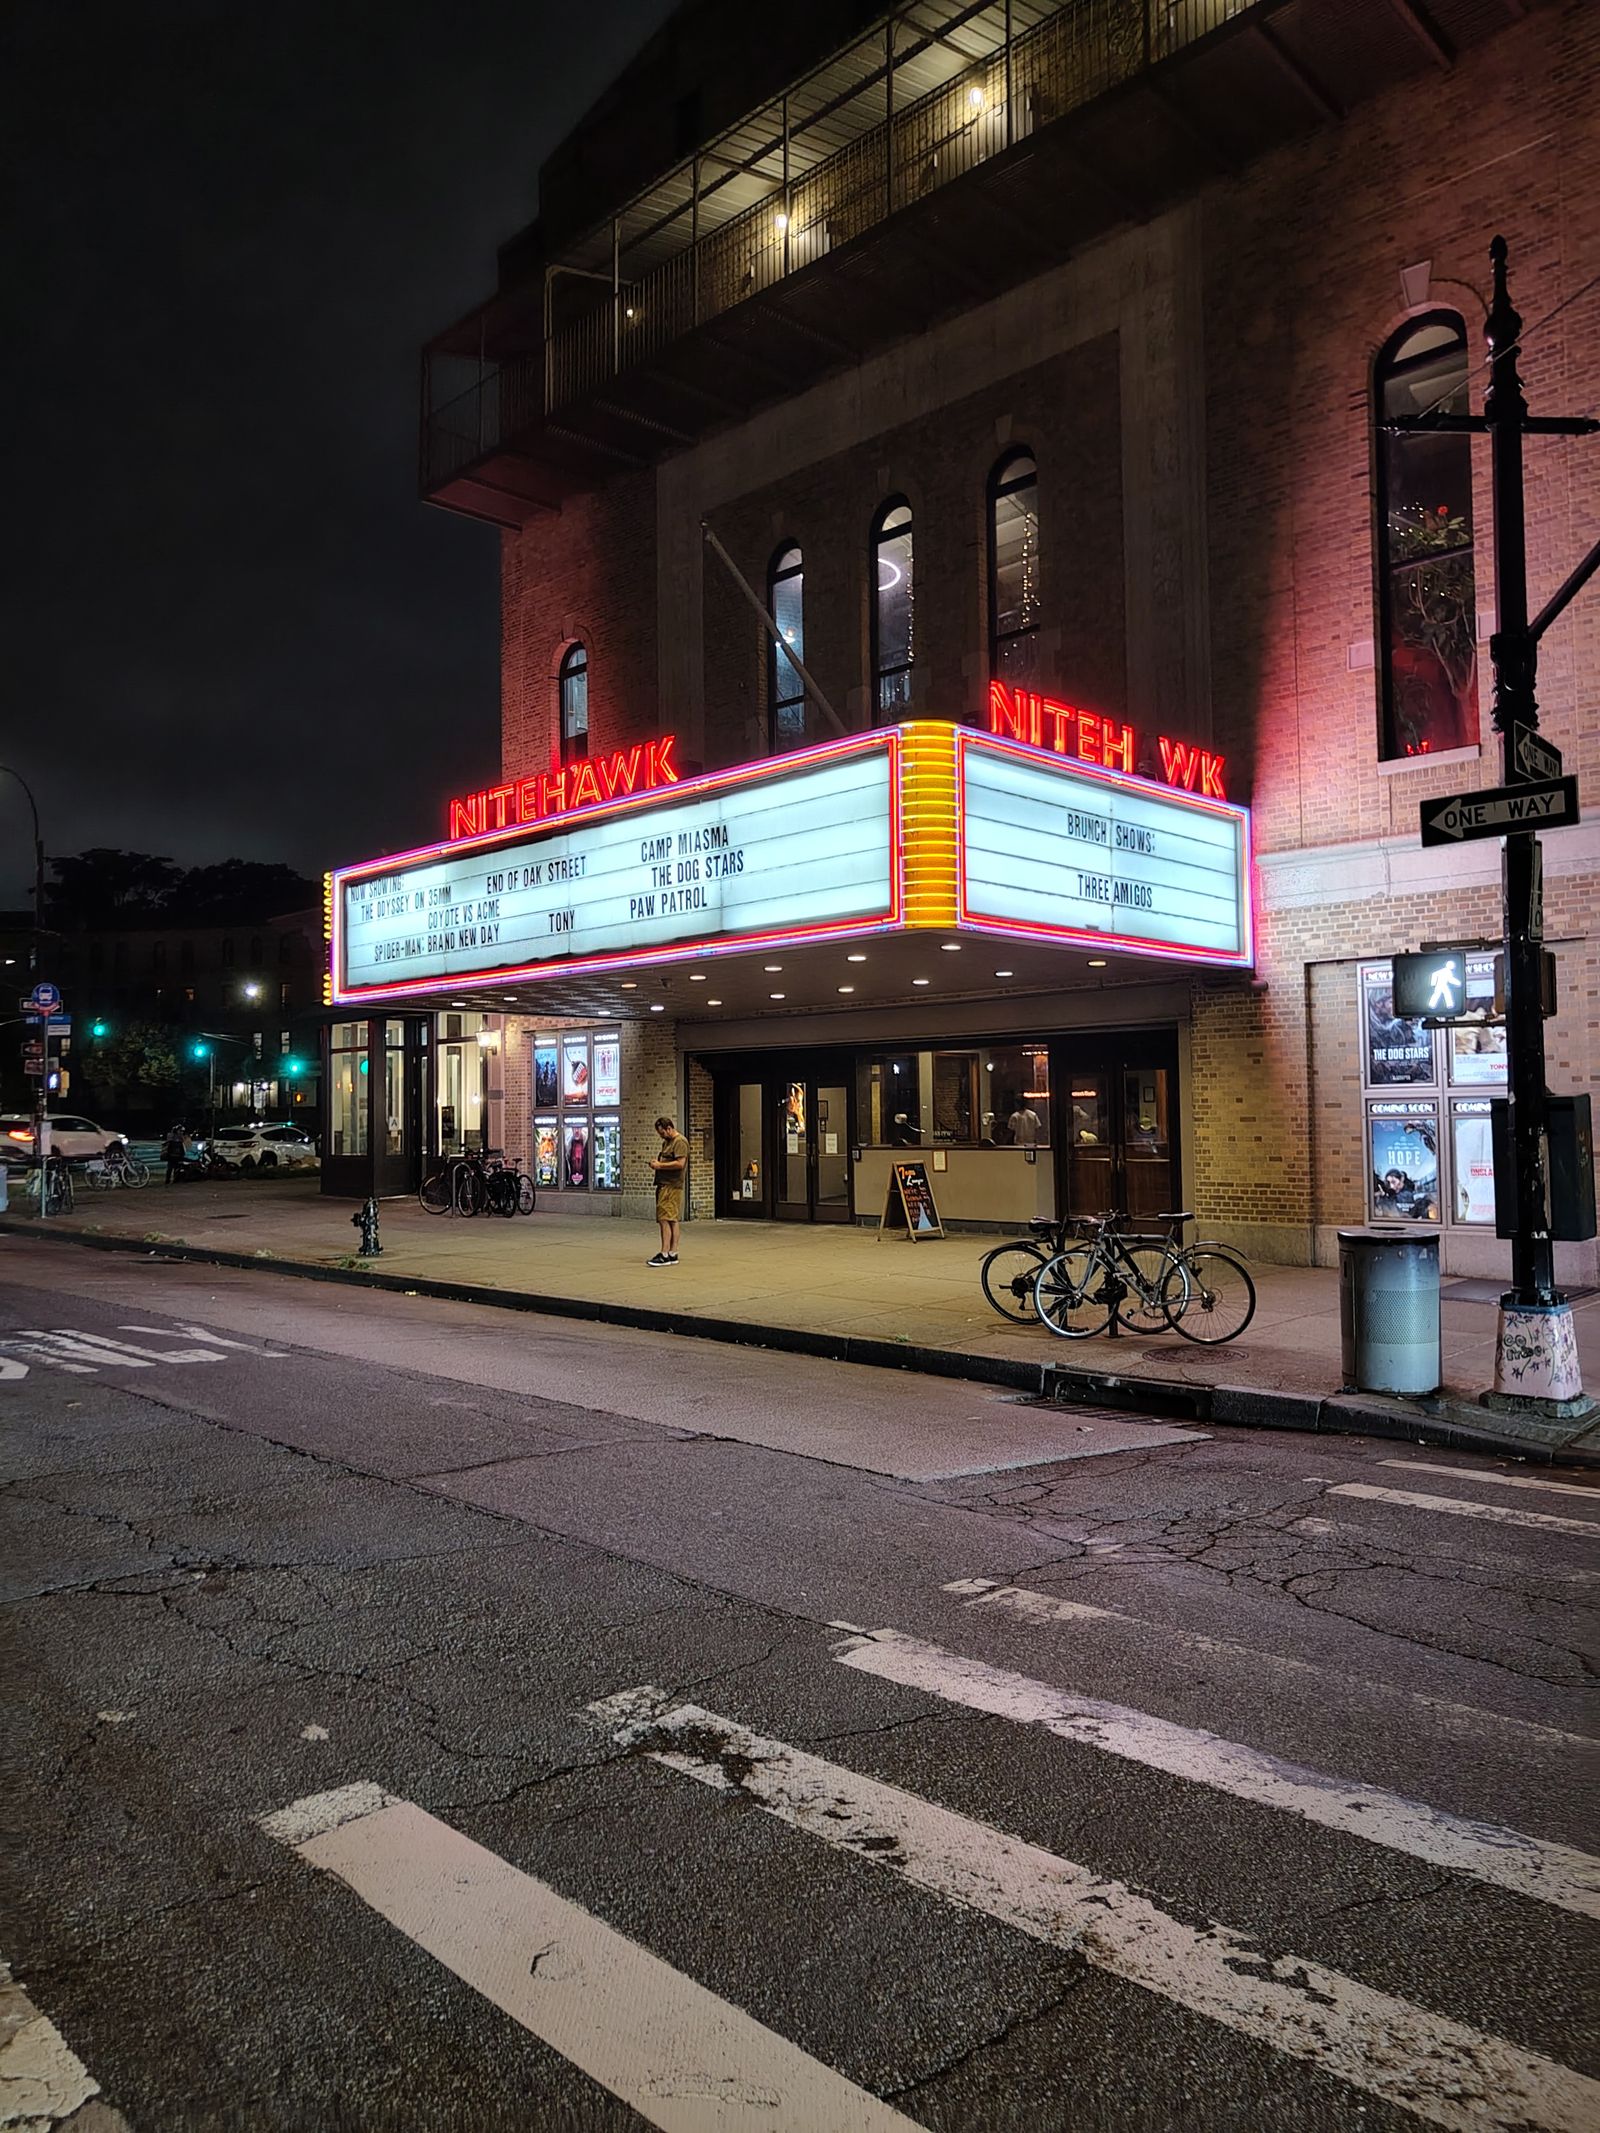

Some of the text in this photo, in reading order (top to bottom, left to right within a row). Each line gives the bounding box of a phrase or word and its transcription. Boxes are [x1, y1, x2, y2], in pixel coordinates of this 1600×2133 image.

[450, 735, 678, 840] NITEHAWK
[1444, 794, 1555, 829] ONE WAY
[641, 824, 729, 862] CAMP MIASMA
[1067, 813, 1155, 853] BRUNCH SHOWS:
[487, 855, 586, 894] END OF OAK STREET
[651, 850, 744, 887] THE DOG STARS
[361, 885, 452, 921] THE ODYSSEY ON 35MM
[630, 886, 707, 919] PAW PATROL
[1078, 874, 1152, 908] THREE AMIGOS
[428, 899, 500, 929] COYOTE VS ACME
[548, 909, 575, 932] TONY
[375, 923, 500, 962] SPIDER-MAN: BRAND NEW DAY
[1373, 1046, 1429, 1061] THE DOG STARS
[1388, 1150, 1421, 1165] HOPE
[744, 1182, 751, 1192] A
